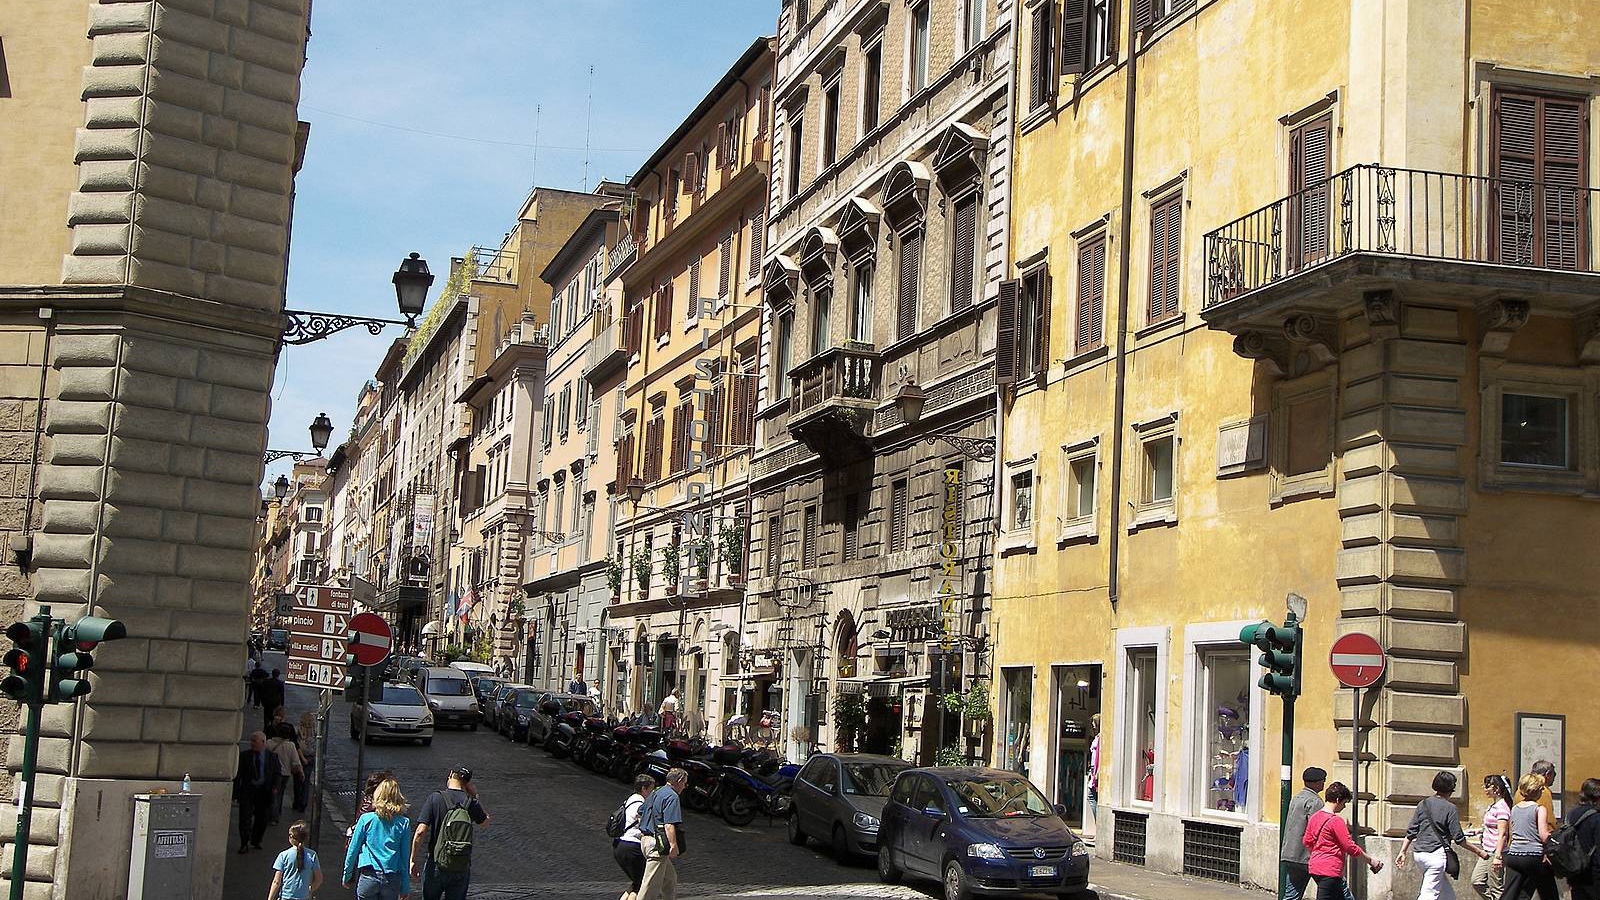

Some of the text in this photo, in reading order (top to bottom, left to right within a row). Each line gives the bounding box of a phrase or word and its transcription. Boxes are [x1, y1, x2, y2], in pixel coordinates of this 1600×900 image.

[681, 298, 718, 598] RISTORANTE
[330, 590, 349, 599] fontana
[293, 615, 314, 626] pincio
[291, 642, 319, 652] villa medici
